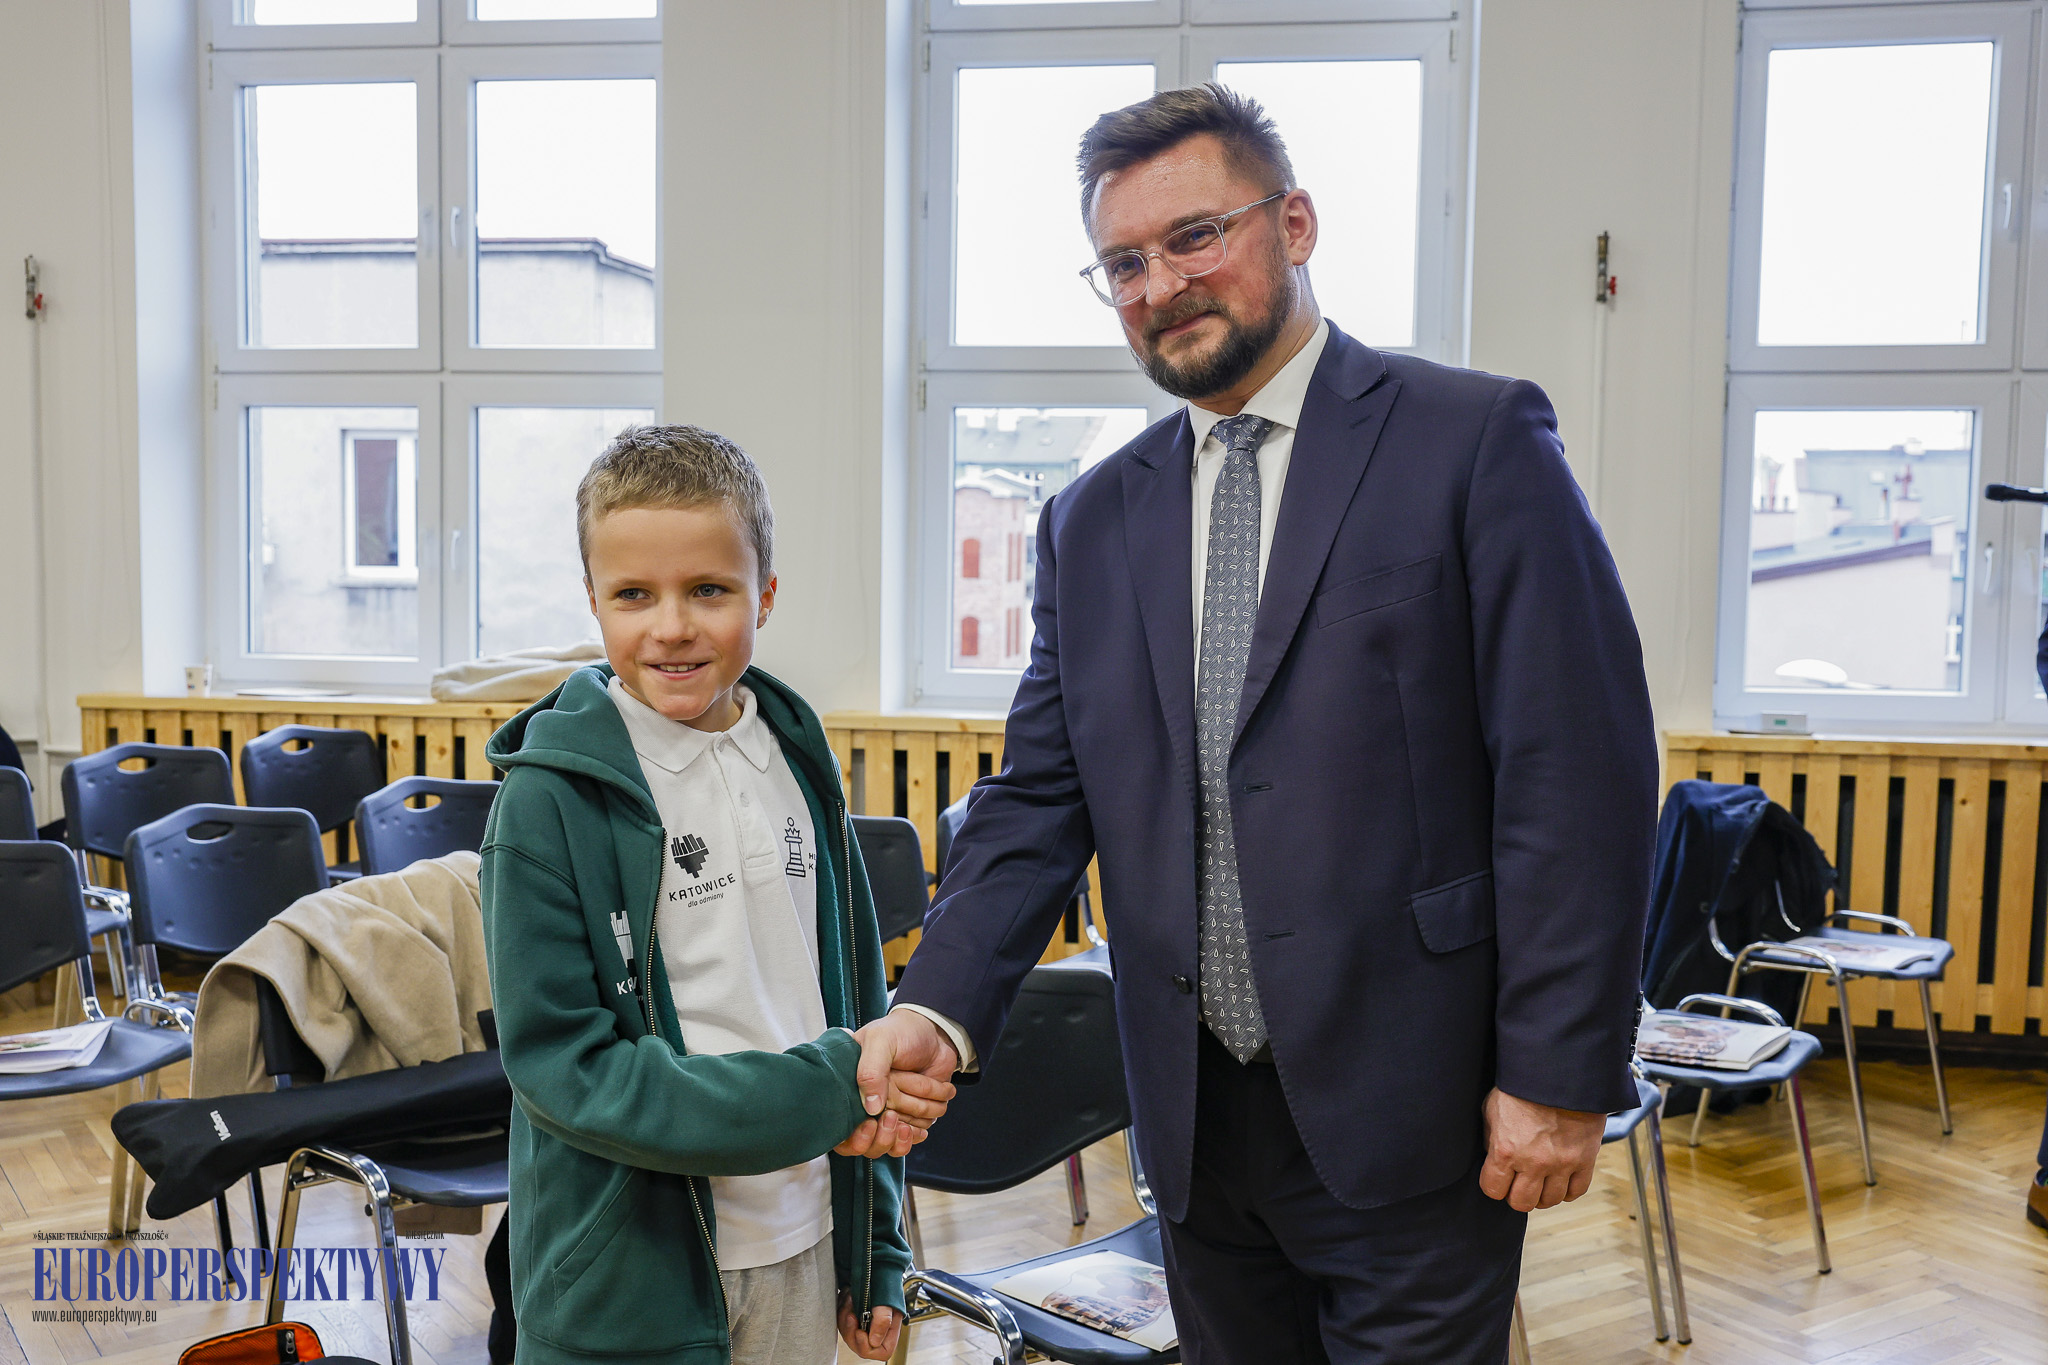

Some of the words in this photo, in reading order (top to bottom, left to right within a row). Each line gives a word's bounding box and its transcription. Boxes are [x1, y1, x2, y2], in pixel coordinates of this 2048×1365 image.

[668, 873, 736, 902] KATOWICE
[687, 899, 698, 908] dla
[699, 892, 724, 905] odmiany
